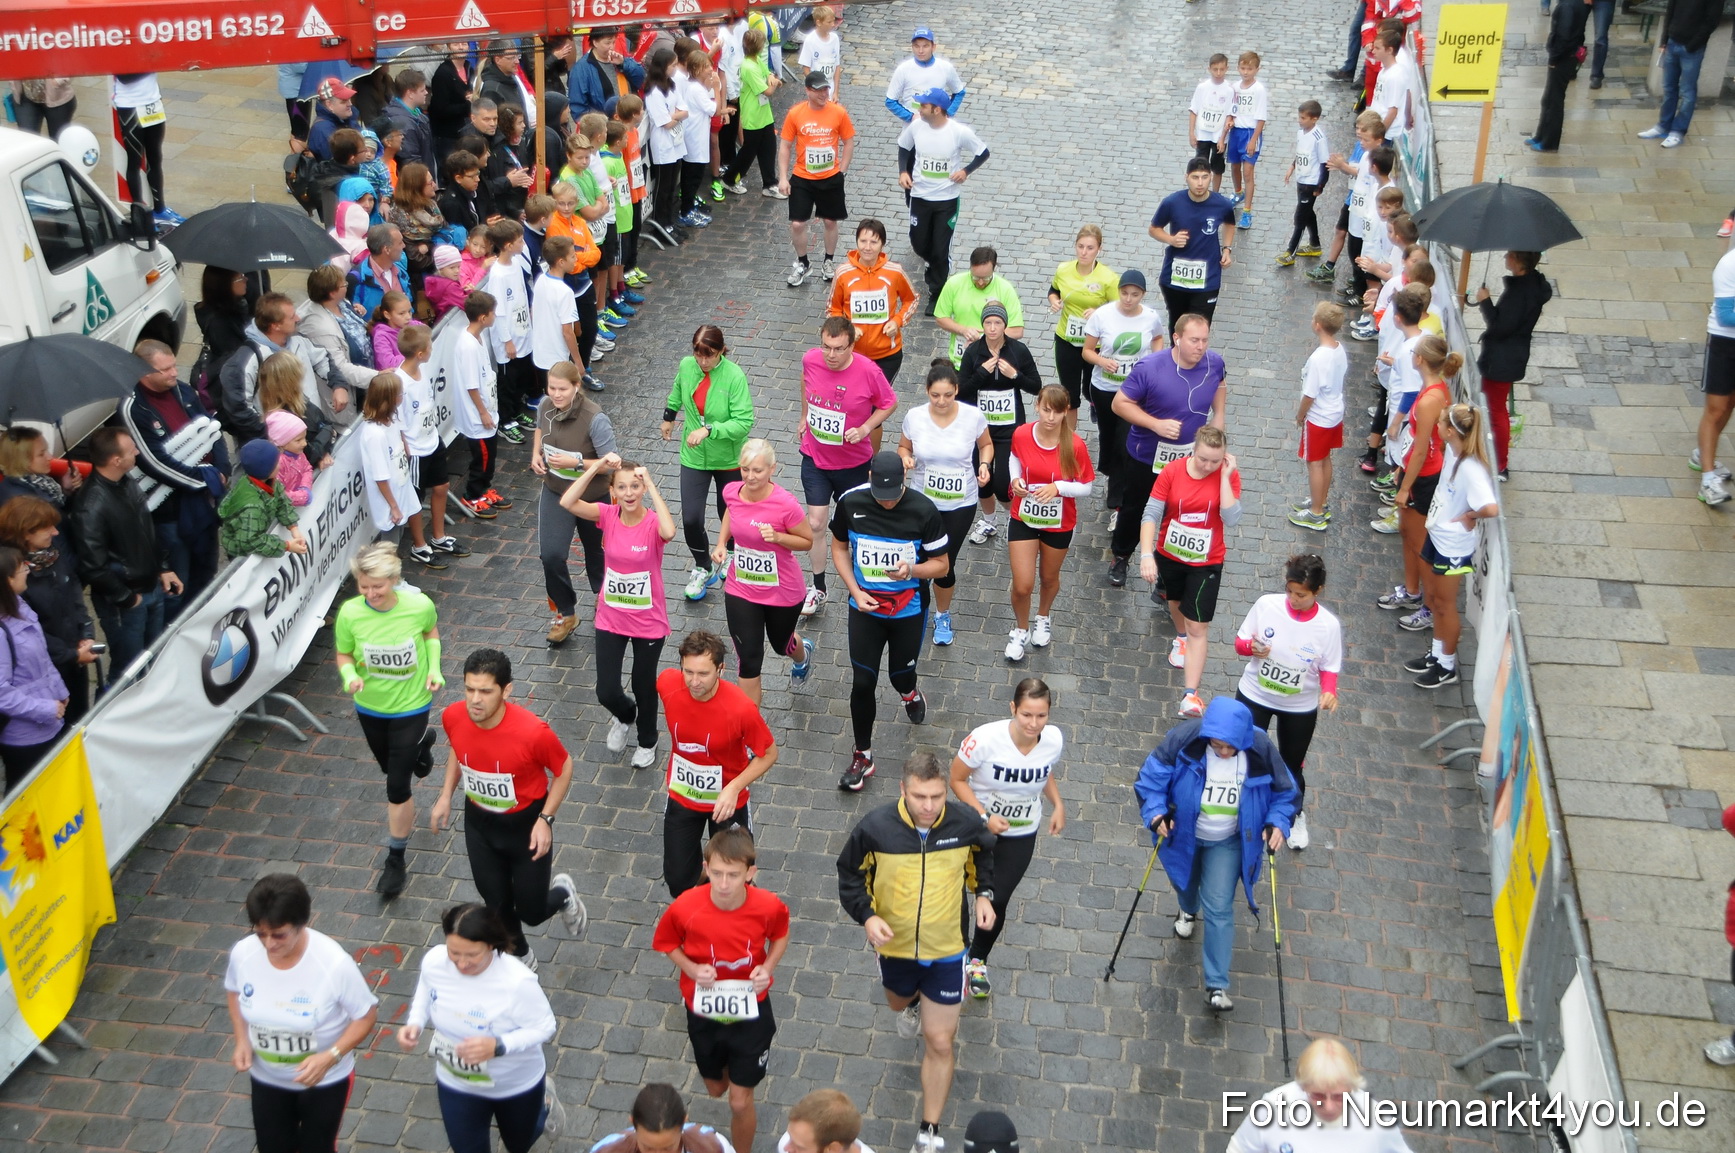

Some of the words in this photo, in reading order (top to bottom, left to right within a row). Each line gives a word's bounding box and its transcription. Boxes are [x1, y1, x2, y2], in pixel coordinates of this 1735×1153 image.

[592, 0, 648, 17] 6352
[0, 25, 132, 52] rviceline:
[139, 20, 212, 44] 09181
[220, 15, 285, 38] 6352
[1438, 30, 1501, 50] Jugend-
[1452, 49, 1484, 65] lauf
[1201, 110, 1222, 123] 4017
[808, 152, 833, 164] 5115
[922, 159, 949, 172] 5164
[1174, 265, 1204, 280] 5019
[854, 298, 886, 313] 5109
[809, 394, 842, 410] IRAN
[979, 398, 1012, 413] 5042
[809, 412, 841, 434] 5133
[927, 474, 963, 492] 5030
[1023, 500, 1058, 518] 5065
[1029, 517, 1049, 525] Nadine
[263, 527, 316, 620] BMW
[315, 469, 367, 552] Efficie
[316, 503, 369, 586] Verbrauch.
[1169, 529, 1206, 552] 5063
[861, 549, 900, 567] 5140
[1176, 547, 1192, 558] Tanja
[737, 554, 773, 573] 5028
[745, 573, 766, 581] Andrea
[607, 579, 647, 596] 5027
[617, 596, 638, 605] Nicole
[369, 650, 413, 667] 5002
[1260, 660, 1302, 687] 5024
[960, 734, 978, 760] 42
[676, 765, 717, 791] 5062
[992, 762, 1051, 784] THULE
[467, 775, 510, 798] 5060
[1204, 785, 1238, 805] 176
[990, 800, 1033, 819] 5081
[8, 904, 38, 940] Pflaster
[14, 893, 68, 956] Außenplatten
[17, 926, 55, 971] Palisaden
[21, 953, 48, 988] Stufen
[701, 994, 750, 1016] 5061
[257, 1032, 311, 1053] 5110
